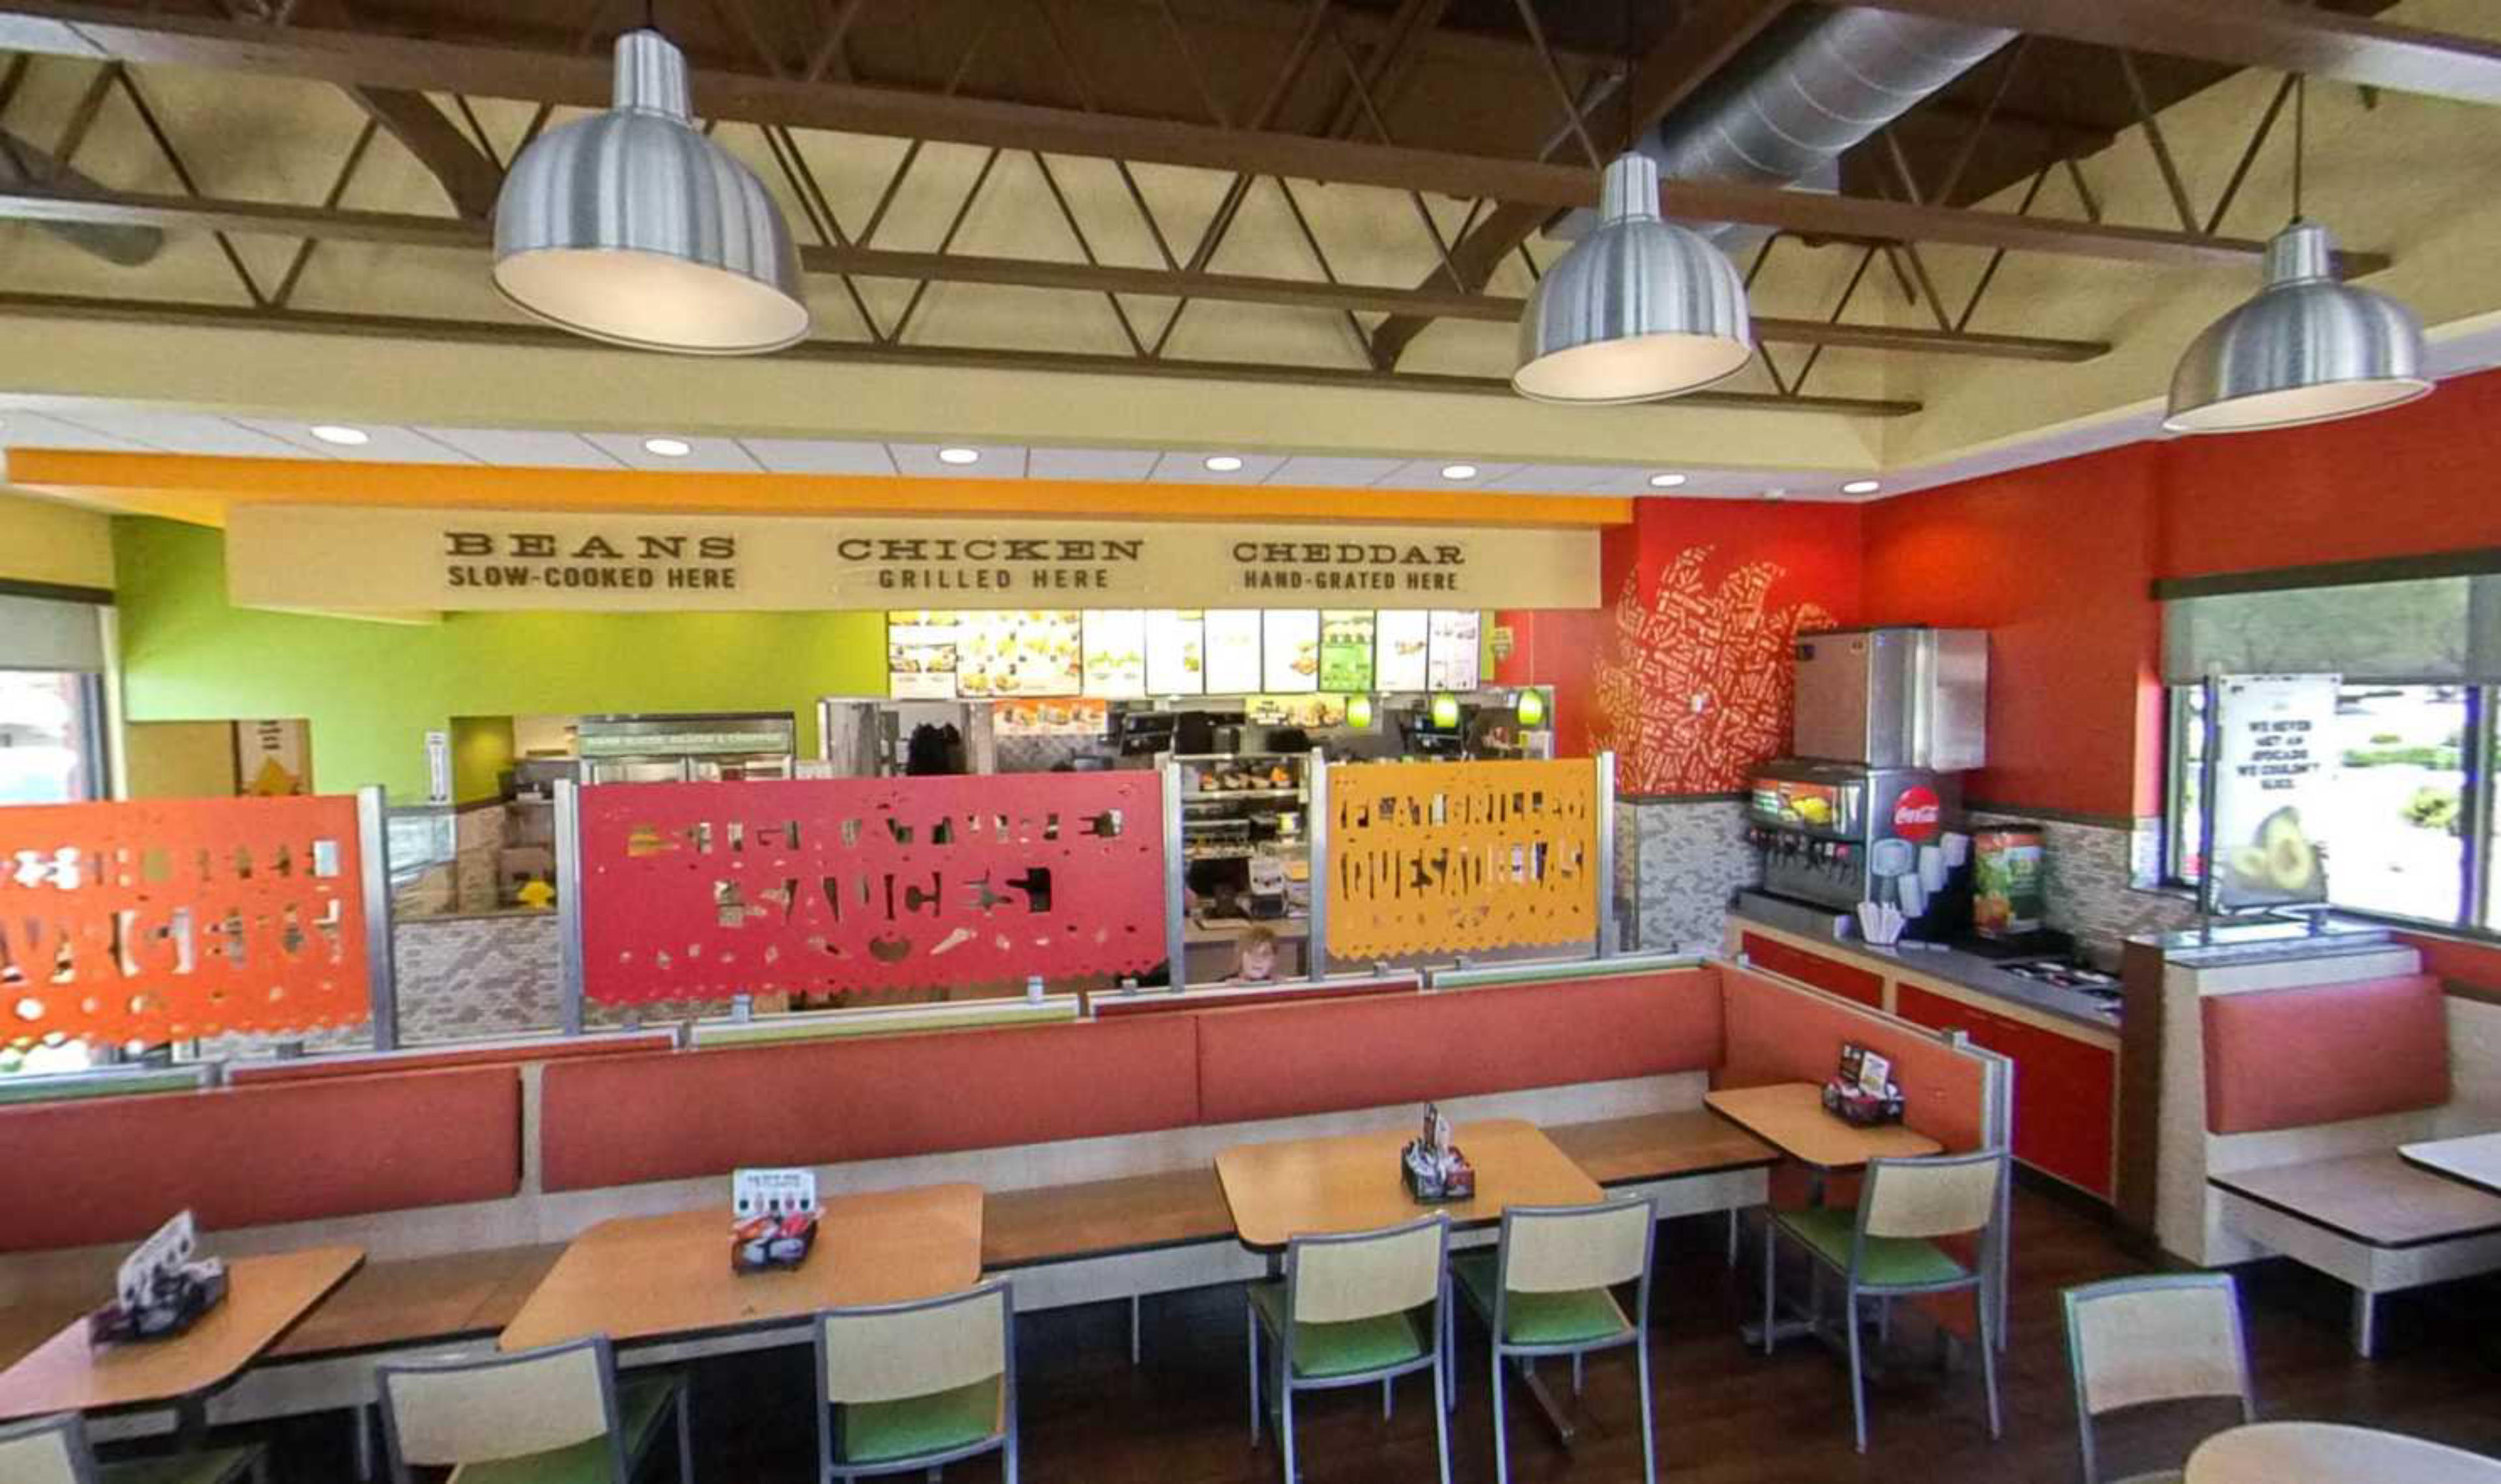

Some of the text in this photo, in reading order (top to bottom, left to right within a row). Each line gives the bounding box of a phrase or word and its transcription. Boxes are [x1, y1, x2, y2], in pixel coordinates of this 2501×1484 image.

[444, 532, 736, 559] BEANS
[838, 539, 1144, 561] CHICKEN
[1232, 542, 1466, 565] CHEDDAR
[447, 565, 736, 588] SLOW-COOKED HERE
[879, 568, 1109, 589] GRILLED HERE
[1244, 570, 1458, 591] HAND-GRATED HERE
